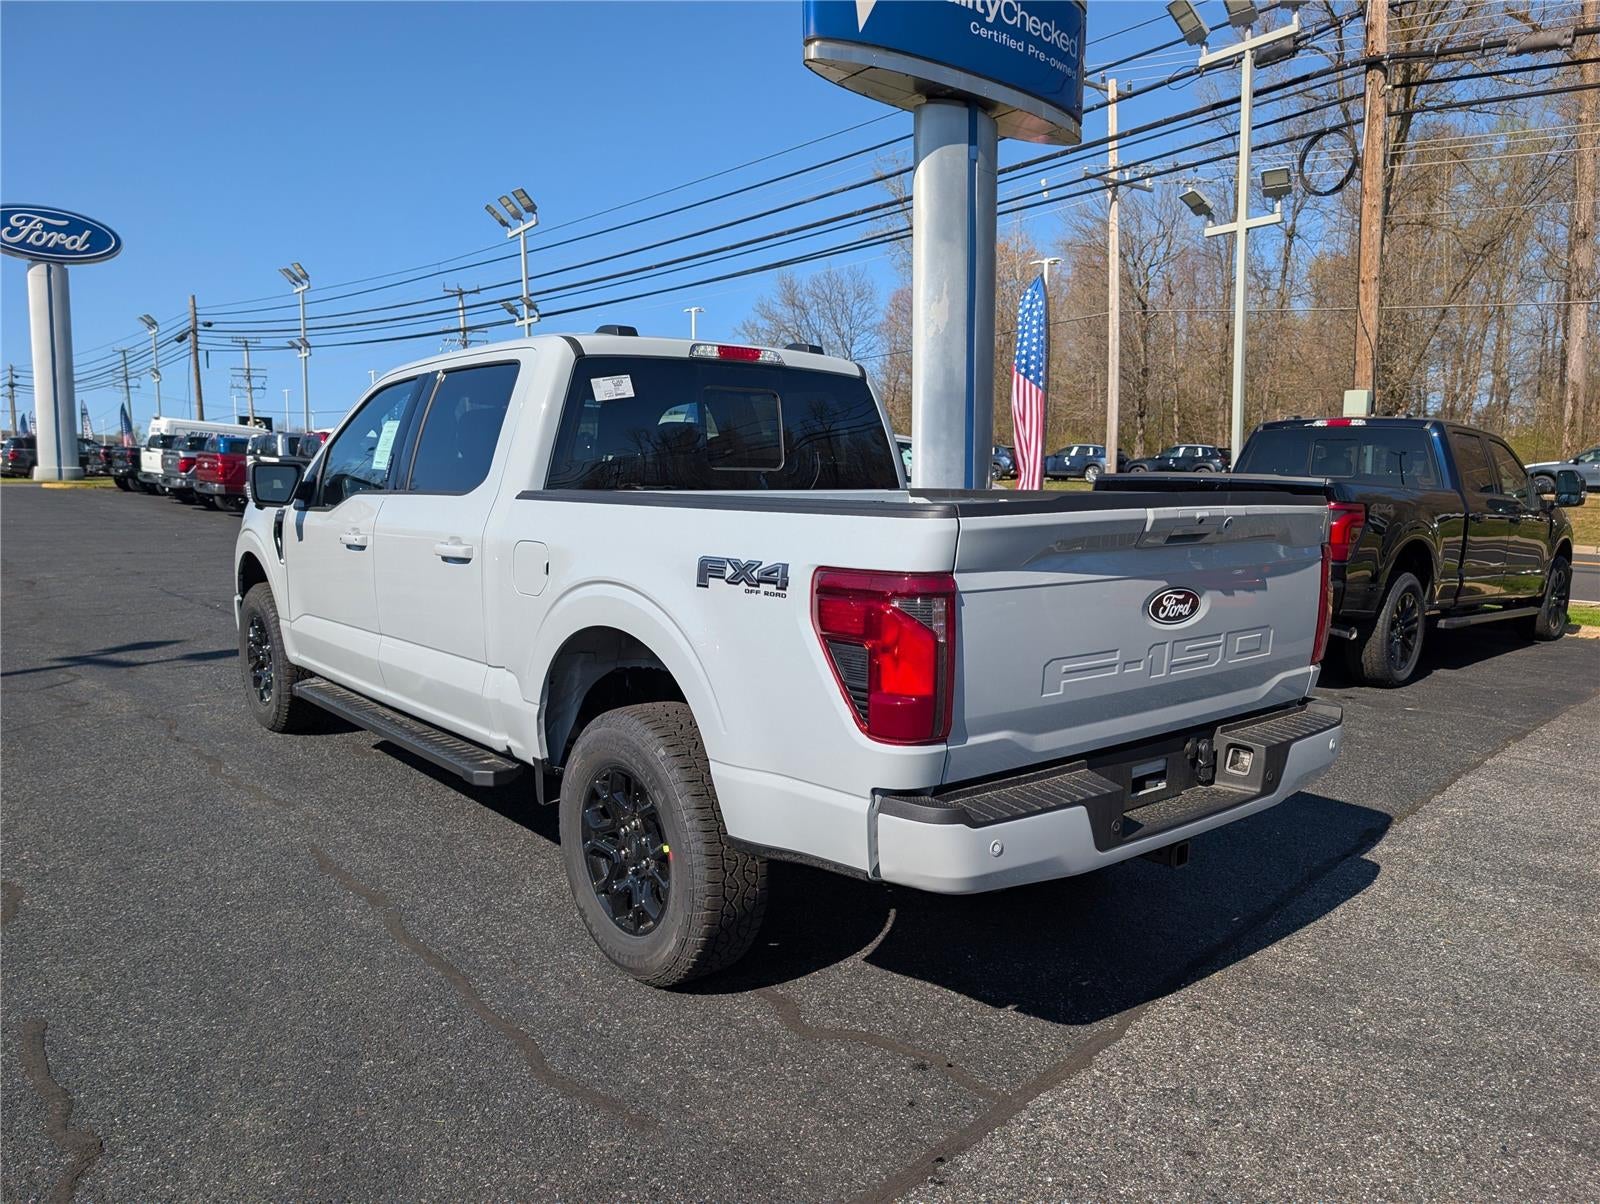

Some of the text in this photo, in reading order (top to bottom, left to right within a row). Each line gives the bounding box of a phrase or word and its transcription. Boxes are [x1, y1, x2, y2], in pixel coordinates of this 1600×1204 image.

[970, 21, 1077, 79] Certified Pre-owned
[1, 213, 92, 251] Ford
[696, 555, 790, 591] FX4
[744, 588, 787, 599] OFF ROAD
[1158, 593, 1193, 619] Ford
[1041, 624, 1275, 698] F-150
